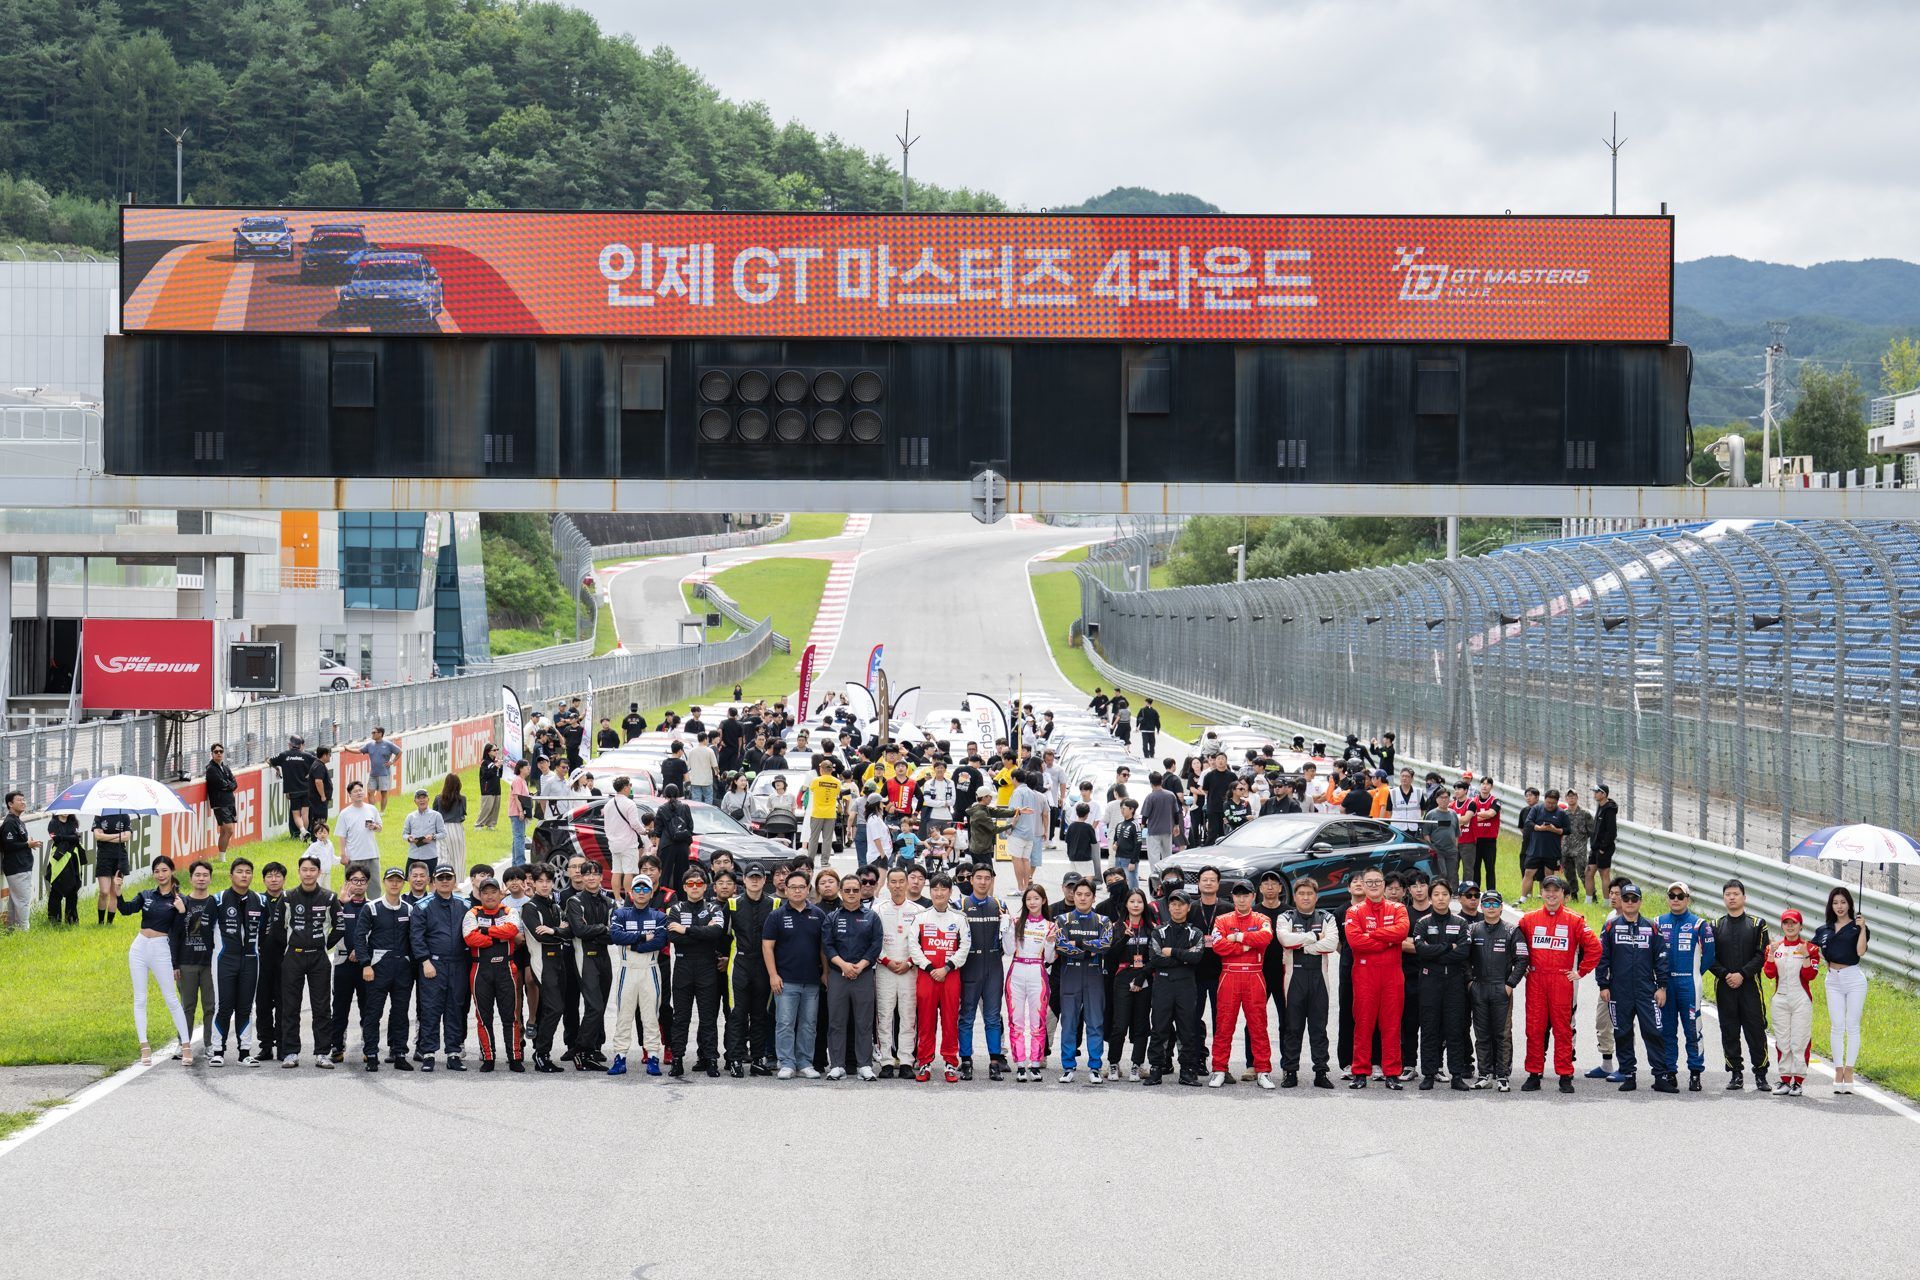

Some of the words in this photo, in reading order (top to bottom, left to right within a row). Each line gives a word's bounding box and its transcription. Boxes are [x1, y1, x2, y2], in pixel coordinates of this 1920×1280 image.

[598, 242, 714, 307] 인제
[732, 248, 822, 304] GT
[836, 245, 1077, 309] 마스터즈
[1093, 246, 1318, 310] 4라운드
[1450, 269, 1480, 284] GT
[1484, 269, 1591, 284] MASTERS
[1448, 287, 1492, 297] INJE
[94, 655, 200, 673] SPEEDIUM
[803, 652, 814, 698] SANGSIN
[901, 785, 910, 809] MEDIA
[928, 938, 955, 947] ROWE
[1533, 937, 1551, 945] TEAM
